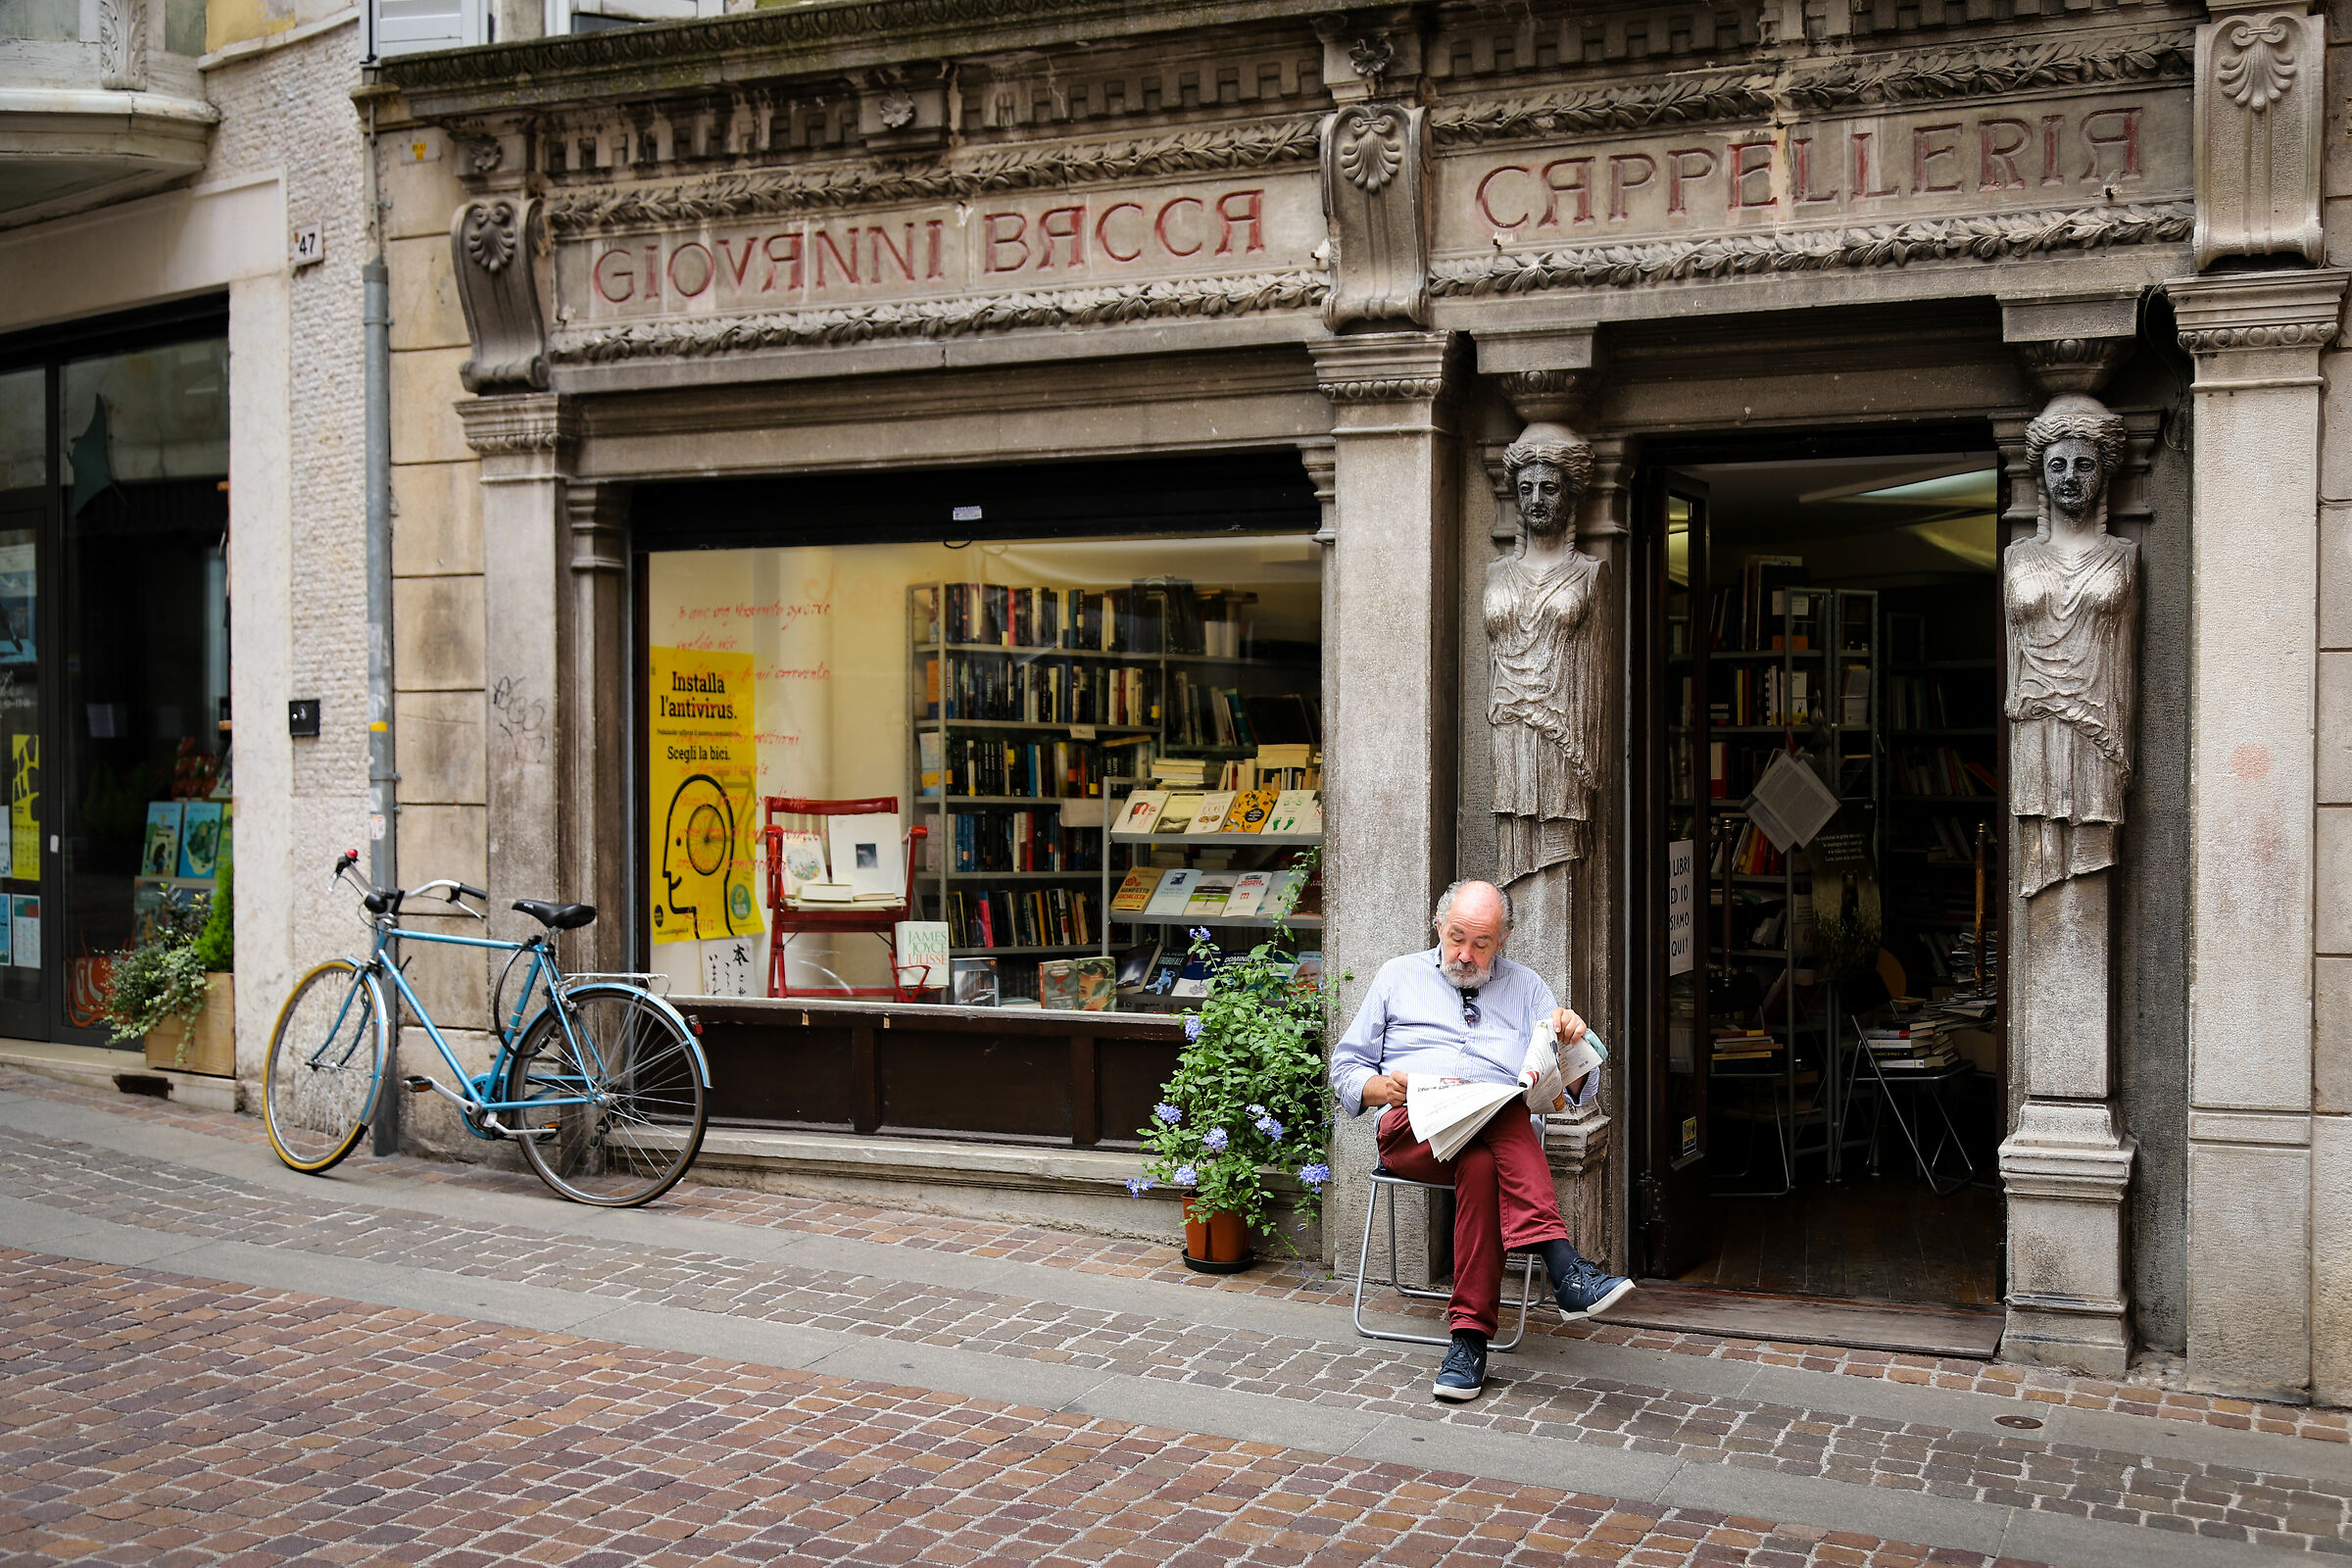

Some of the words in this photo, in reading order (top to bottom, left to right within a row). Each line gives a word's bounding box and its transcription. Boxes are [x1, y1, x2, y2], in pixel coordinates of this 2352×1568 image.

[1475, 105, 2144, 229] CAPPELLERIA
[299, 232, 316, 255] 47
[593, 219, 947, 303] GIOVANNI
[983, 188, 1266, 274] BACCA
[671, 670, 725, 694] Installa
[660, 694, 738, 719] l'antivirus.
[667, 745, 697, 764] Scegli
[699, 745, 709, 760] la
[710, 745, 732, 760] bici.
[1673, 856, 1691, 877] LIBRI
[1670, 887, 1679, 905] ED
[1681, 883, 1689, 903] IO
[1669, 911, 1690, 931] SIAMO
[908, 930, 948, 946] JAMES
[907, 954, 949, 965] ULISSE
[912, 942, 948, 956] JOYCE
